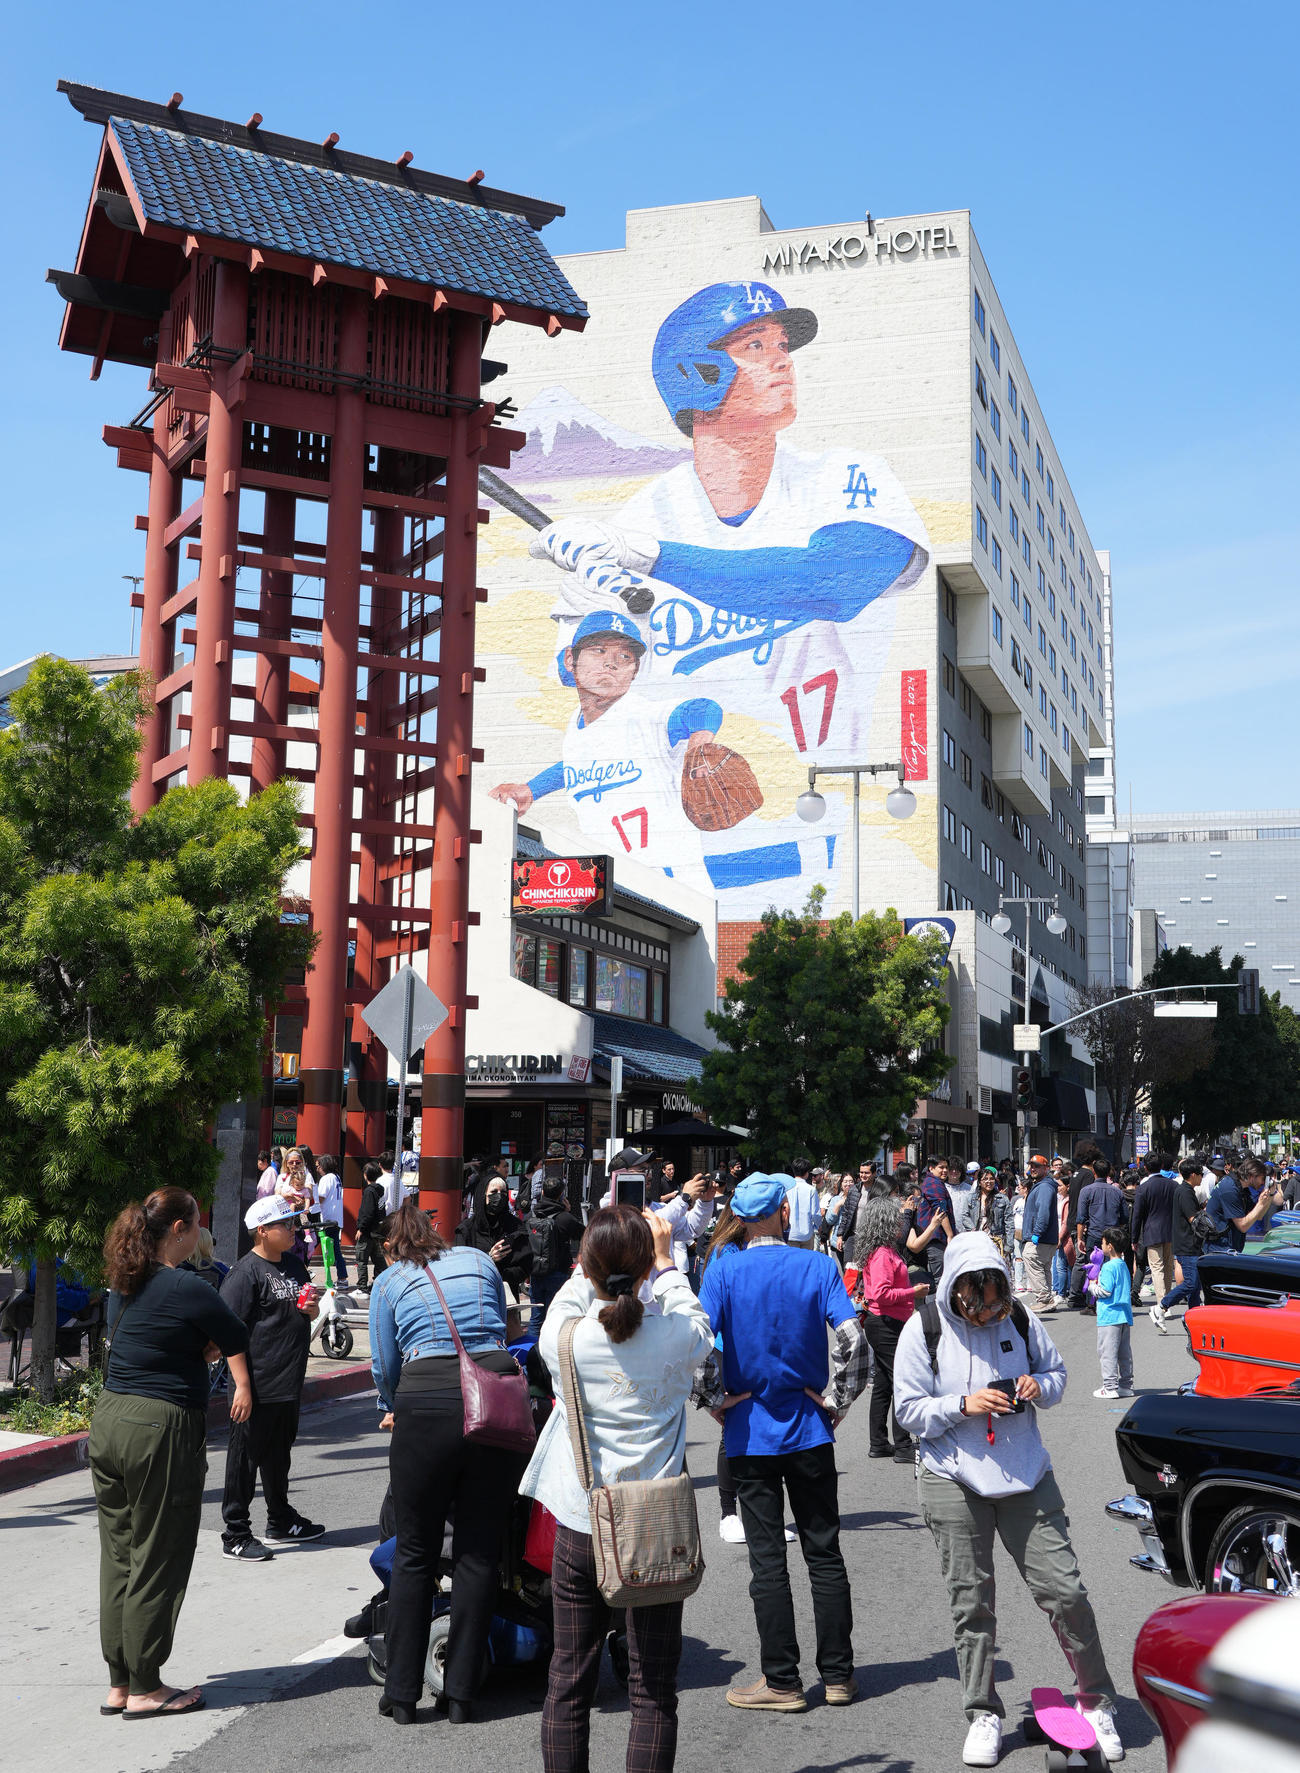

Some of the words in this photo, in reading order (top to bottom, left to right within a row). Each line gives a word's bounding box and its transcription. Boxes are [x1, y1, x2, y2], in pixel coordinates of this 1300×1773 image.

[762, 235, 866, 269] MIYAKO
[874, 225, 957, 256] HOTEL
[742, 282, 773, 313] LA
[842, 463, 877, 509] LA
[780, 669, 839, 752] 17
[563, 760, 638, 803] Dodgers
[611, 806, 648, 853] 17
[521, 887, 596, 899] CHINCHIKURIN
[465, 1055, 563, 1074] CHIKURIN
